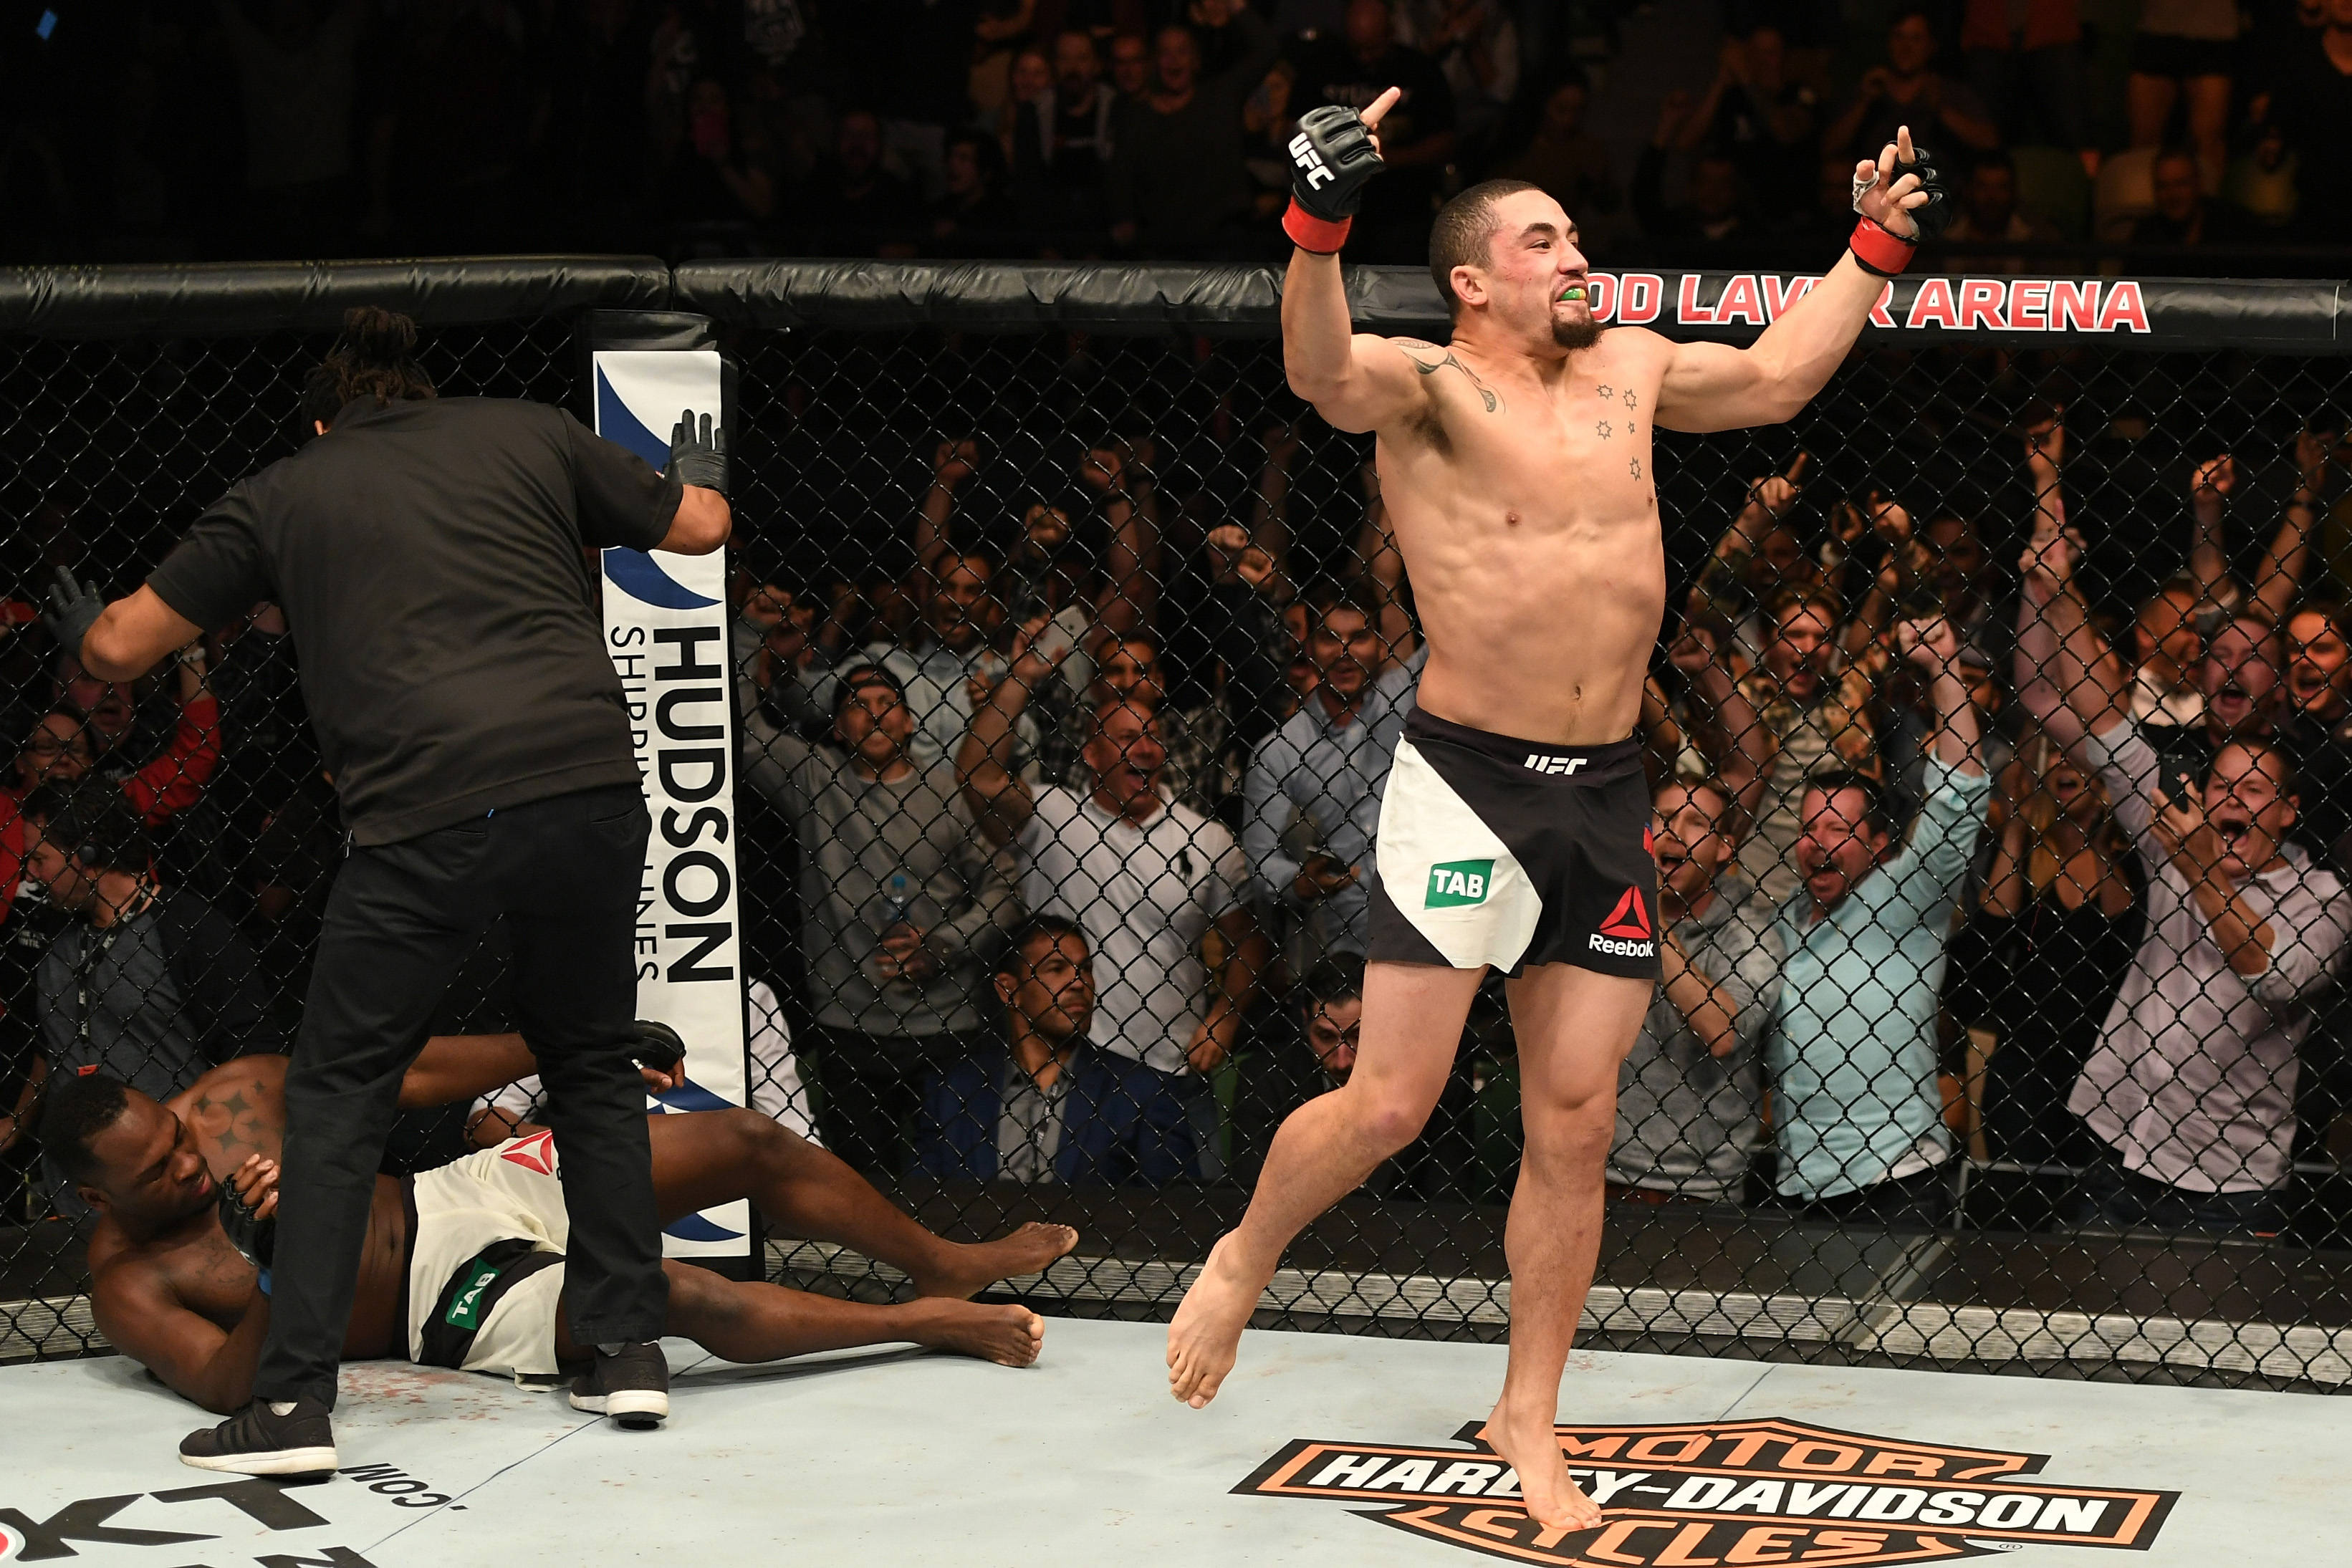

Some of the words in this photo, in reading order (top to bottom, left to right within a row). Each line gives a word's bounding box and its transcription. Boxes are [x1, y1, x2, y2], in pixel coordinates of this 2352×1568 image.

[1288, 132, 1335, 191] UFC
[1588, 272, 1664, 324] OD
[1677, 274, 1899, 329] LAV
[1905, 278, 2151, 334] ARENA
[610, 625, 651, 799] SHIPP
[1524, 754, 1588, 775] UFC
[653, 626, 734, 983] HUDSON
[1433, 869, 1484, 898] TAB
[1588, 933, 1654, 958] Reebok
[451, 1272, 496, 1319] TAB
[1556, 1431, 1946, 1478] MOTOR
[1307, 1454, 2110, 1534] HARLY-DAVIDSON
